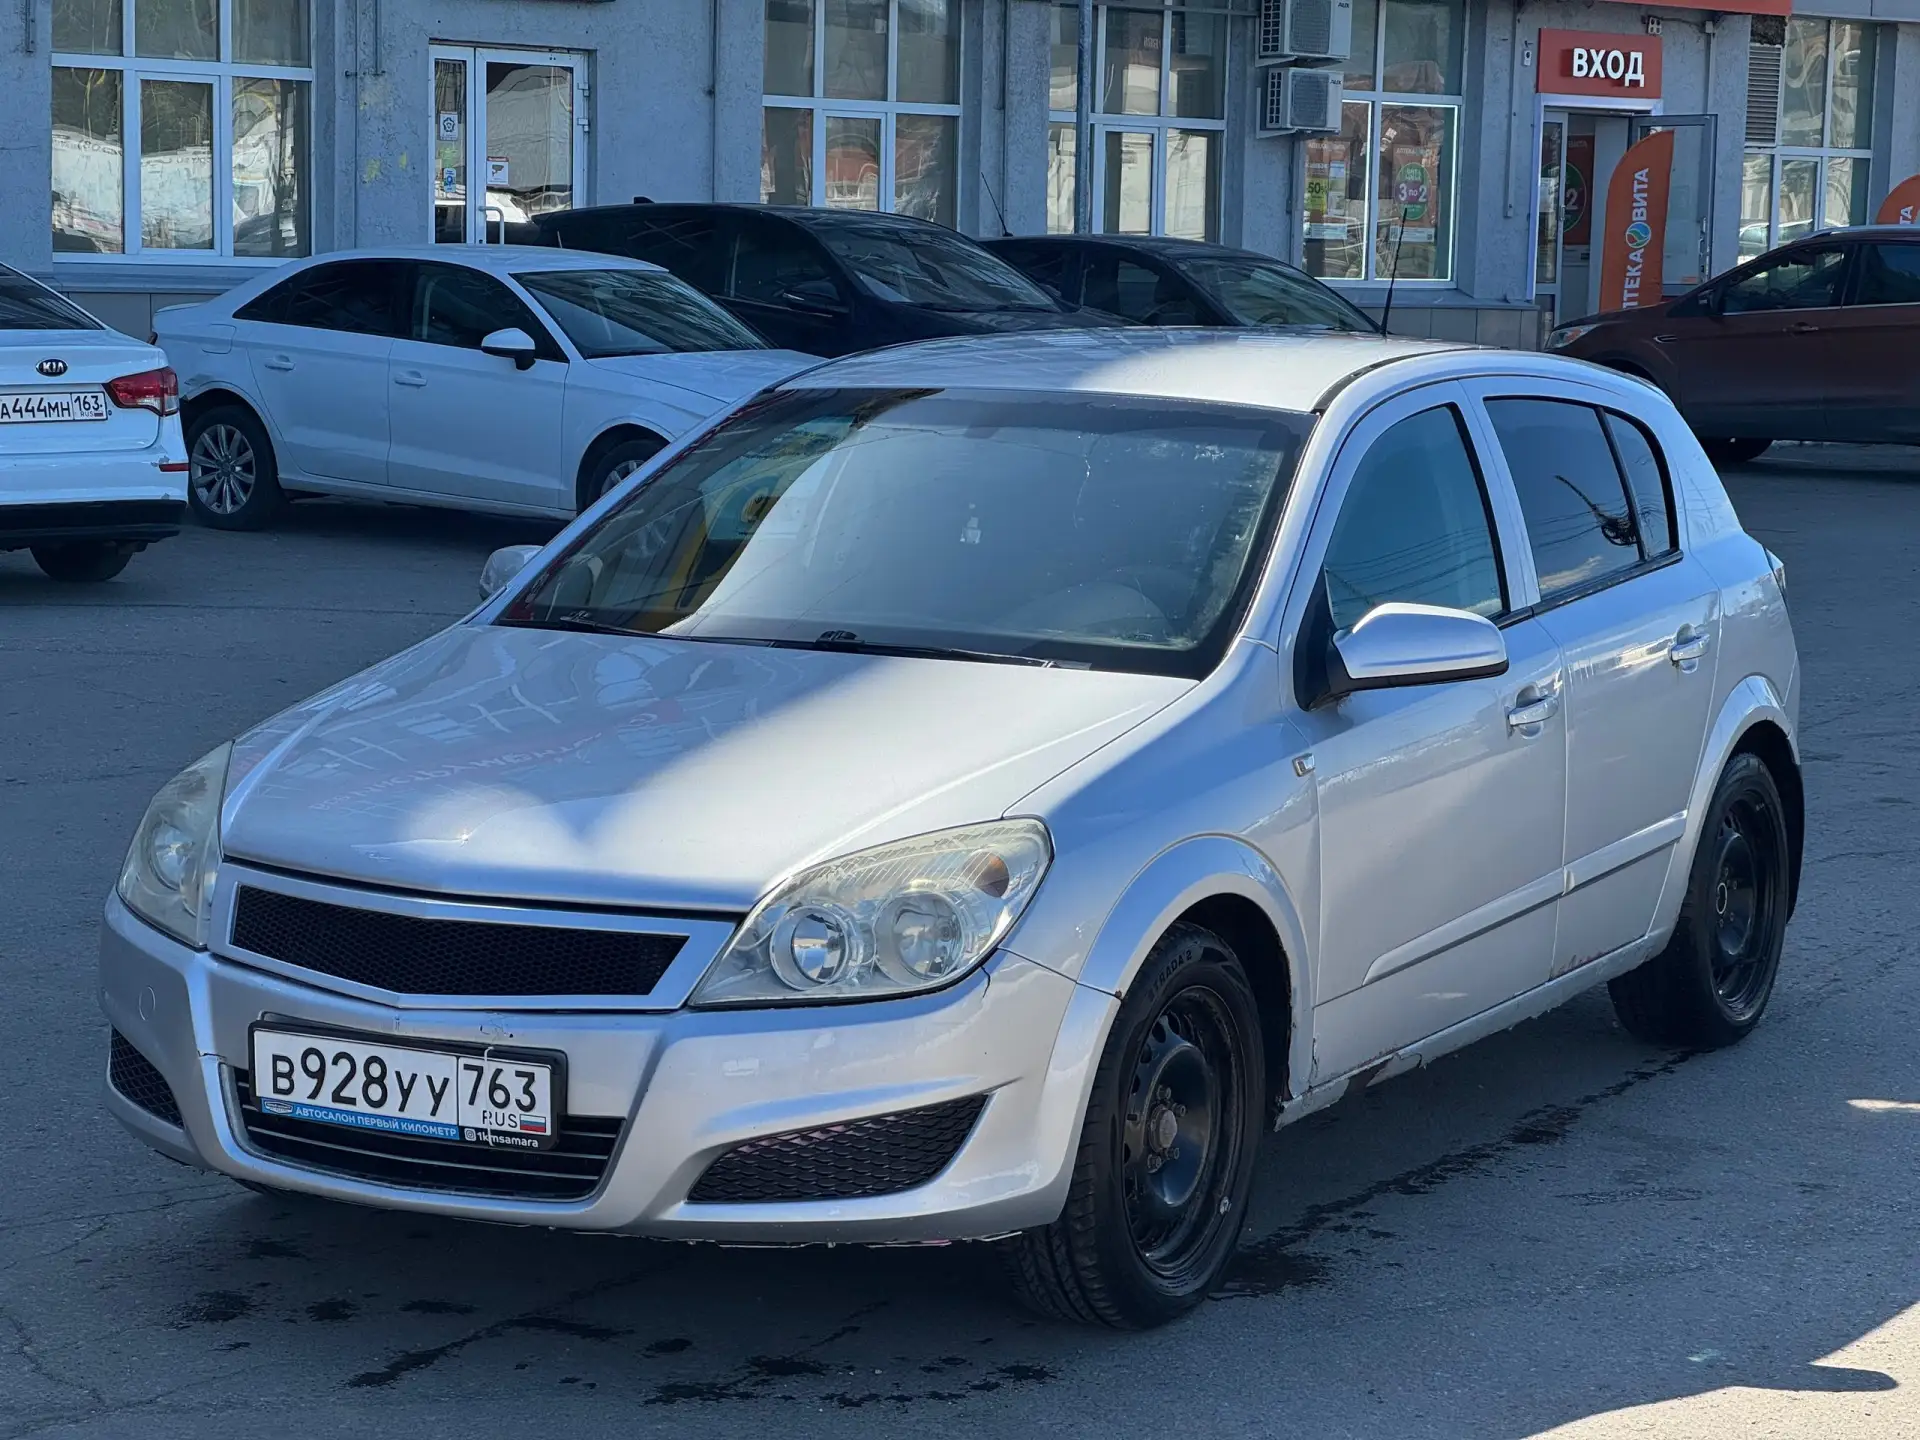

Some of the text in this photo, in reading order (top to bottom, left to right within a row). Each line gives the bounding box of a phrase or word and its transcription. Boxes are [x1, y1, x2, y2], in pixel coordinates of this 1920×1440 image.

[1573, 48, 1645, 87] ВХОД
[1399, 183, 1428, 203] 3 по 2
[1632, 168, 1649, 221] ВИТА
[42, 361, 65, 373] KIA
[0, 395, 100, 419] А444МН 163
[272, 1047, 536, 1116] В928УУ 763
[295, 1106, 356, 1123] АВТОСАЛОН
[357, 1116, 400, 1130] ПЕРВЫЙ
[401, 1121, 457, 1137] КИЛОМЕТР
[482, 1109, 518, 1128] RUS
[477, 1131, 539, 1148] 1kmsamara
